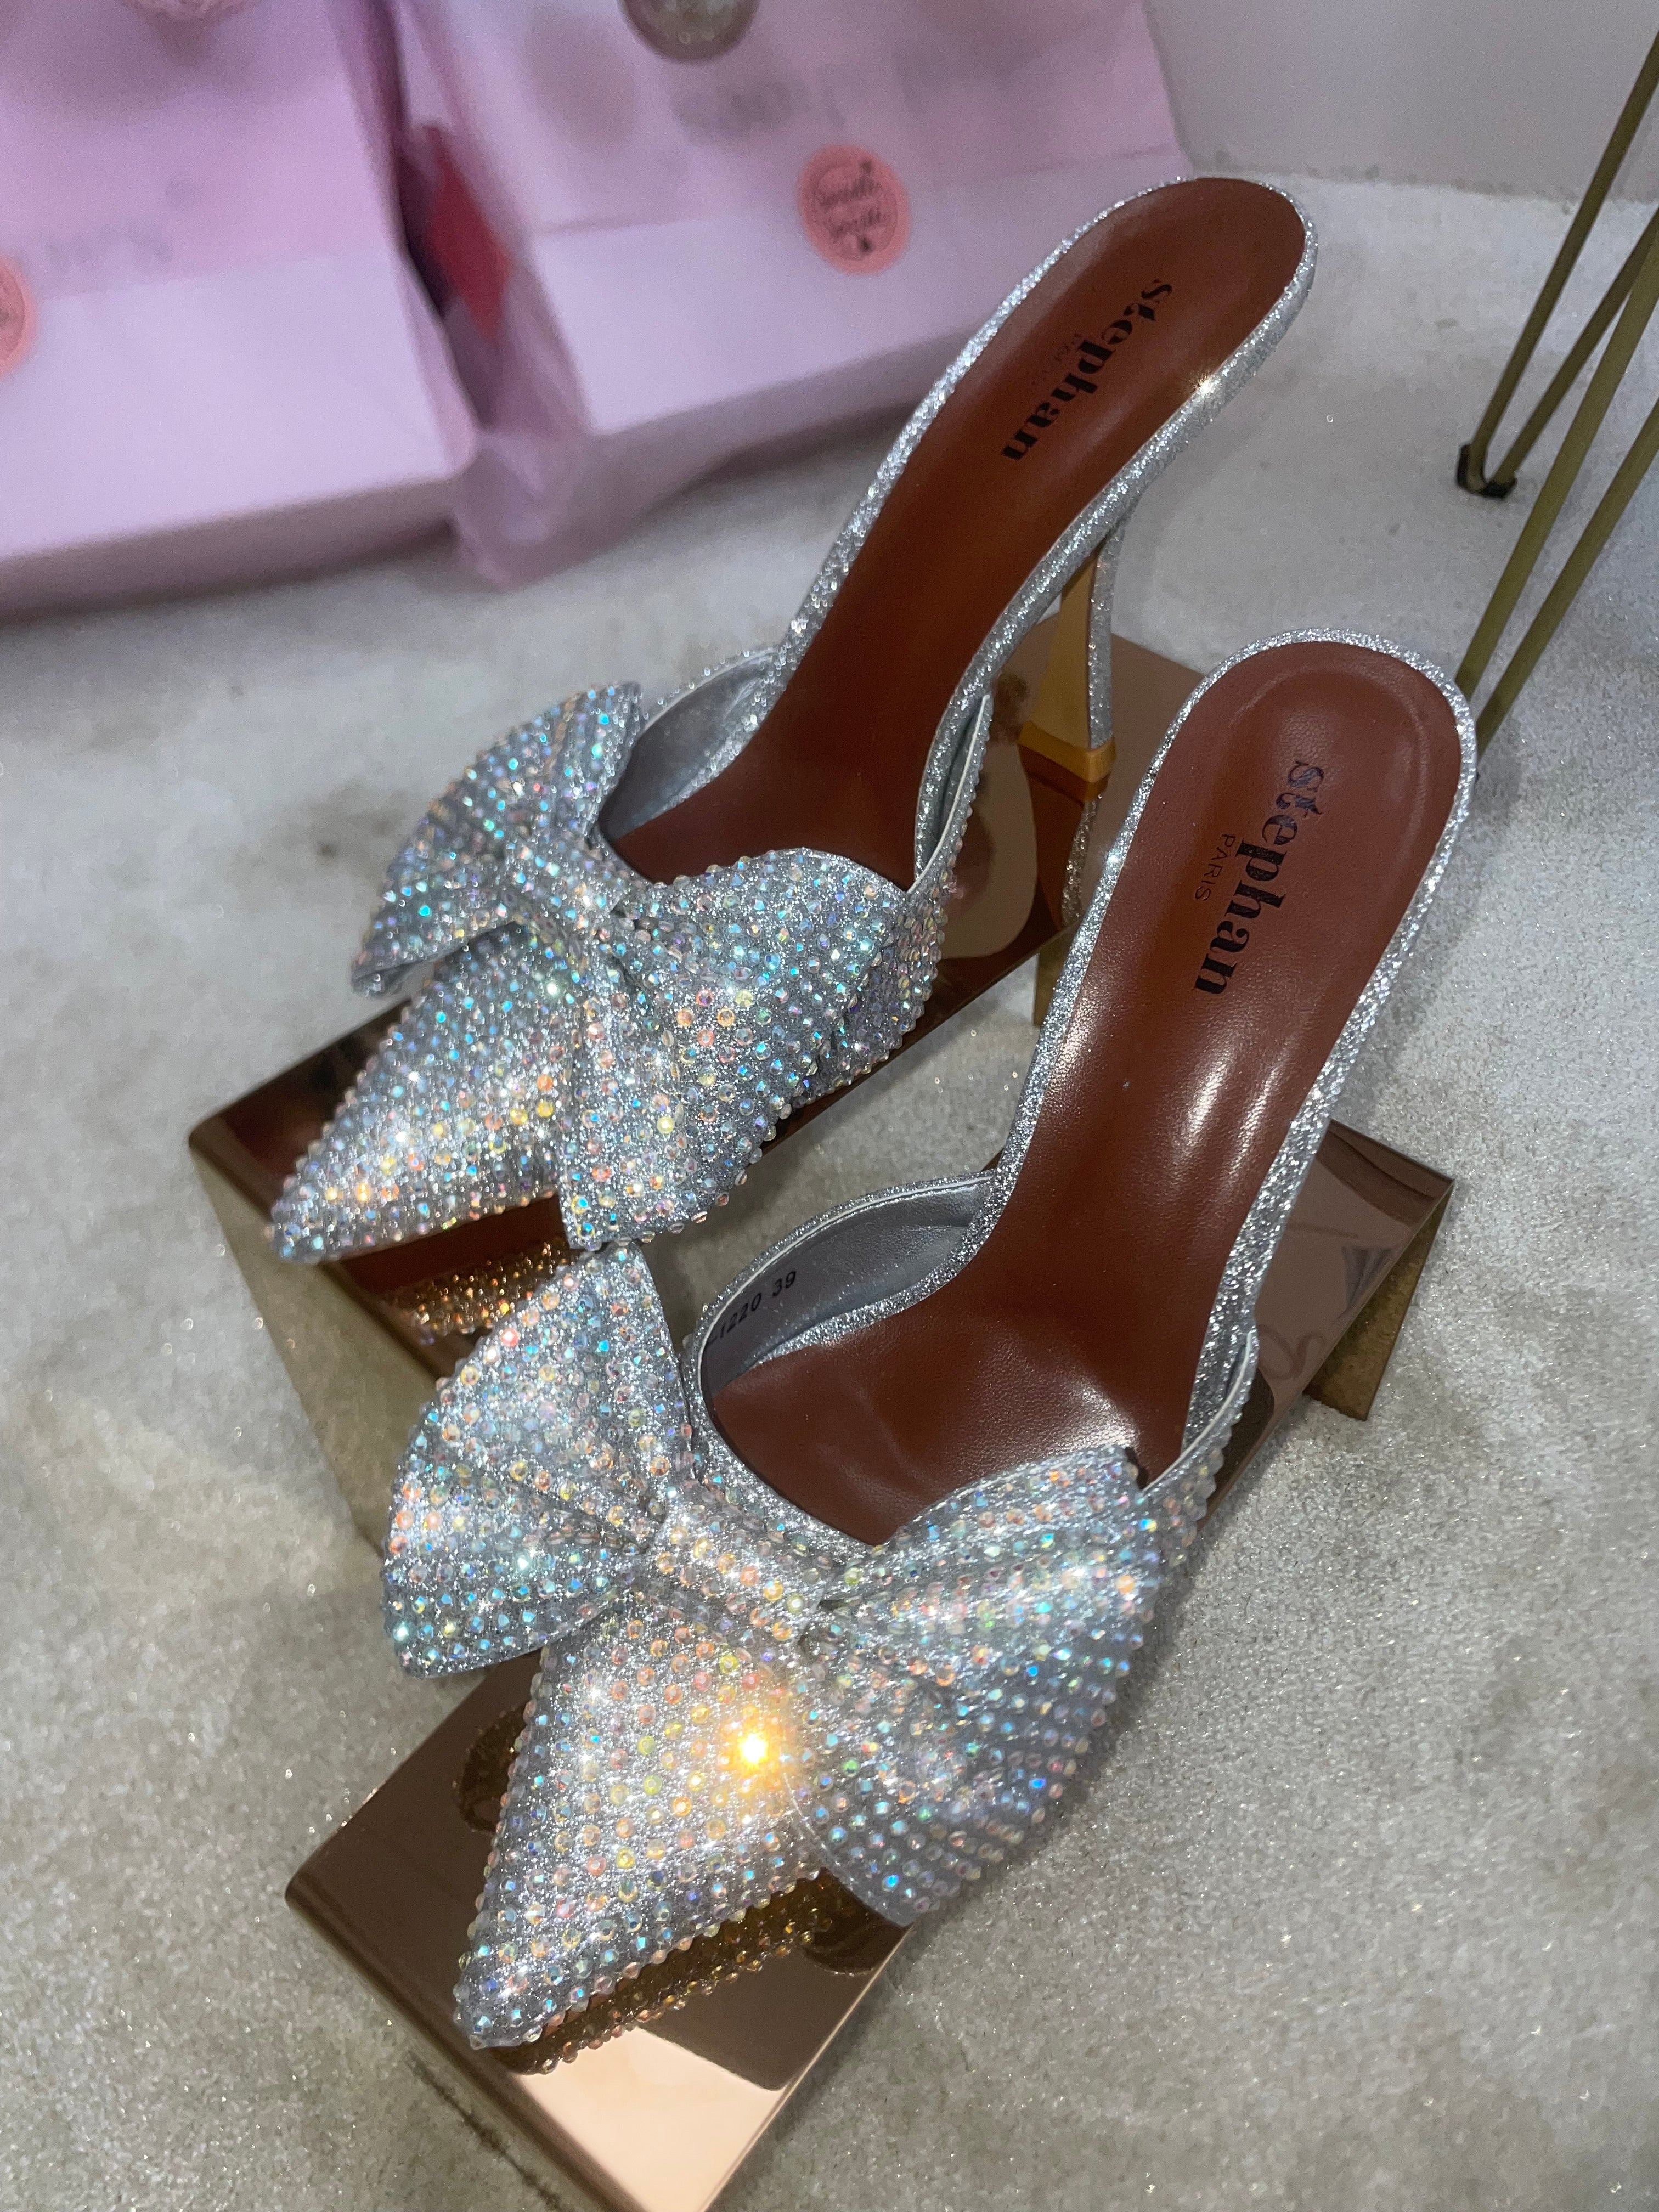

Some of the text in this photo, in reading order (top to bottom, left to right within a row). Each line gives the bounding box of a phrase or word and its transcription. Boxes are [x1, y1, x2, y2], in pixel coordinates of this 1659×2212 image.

[1001, 279, 1173, 460] stephan
[1192, 761, 1324, 995] stephan
[1195, 833, 1236, 901] PARIS
[772, 1271, 797, 1298] 39
